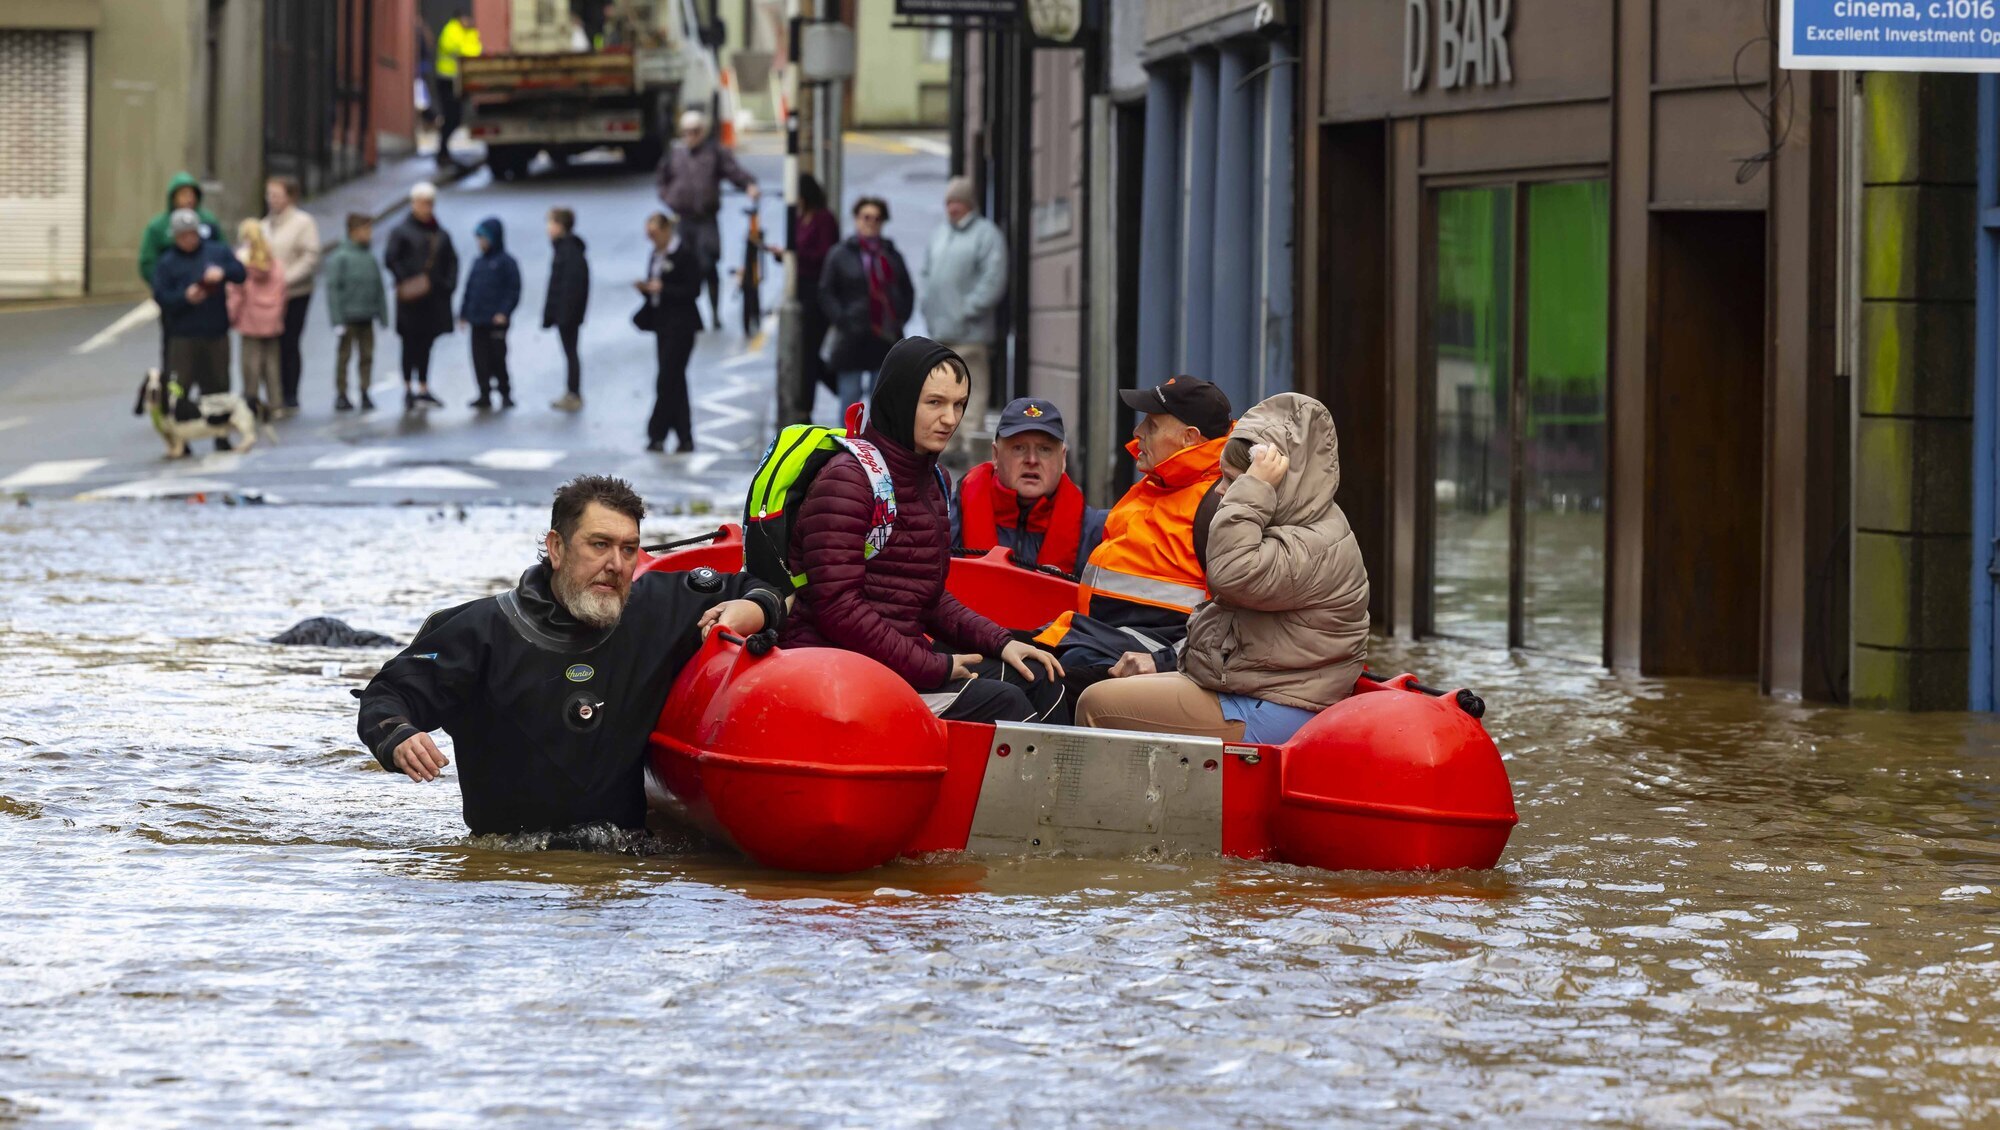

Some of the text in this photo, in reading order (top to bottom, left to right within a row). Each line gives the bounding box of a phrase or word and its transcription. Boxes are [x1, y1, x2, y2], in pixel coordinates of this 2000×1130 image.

[1833, 0, 1995, 20] cinema, c.1016
[1403, 0, 1511, 91] D BAR
[1806, 26, 1880, 41] Excellent
[1885, 27, 1976, 43] Investment
[845, 438, 883, 475] llogg's
